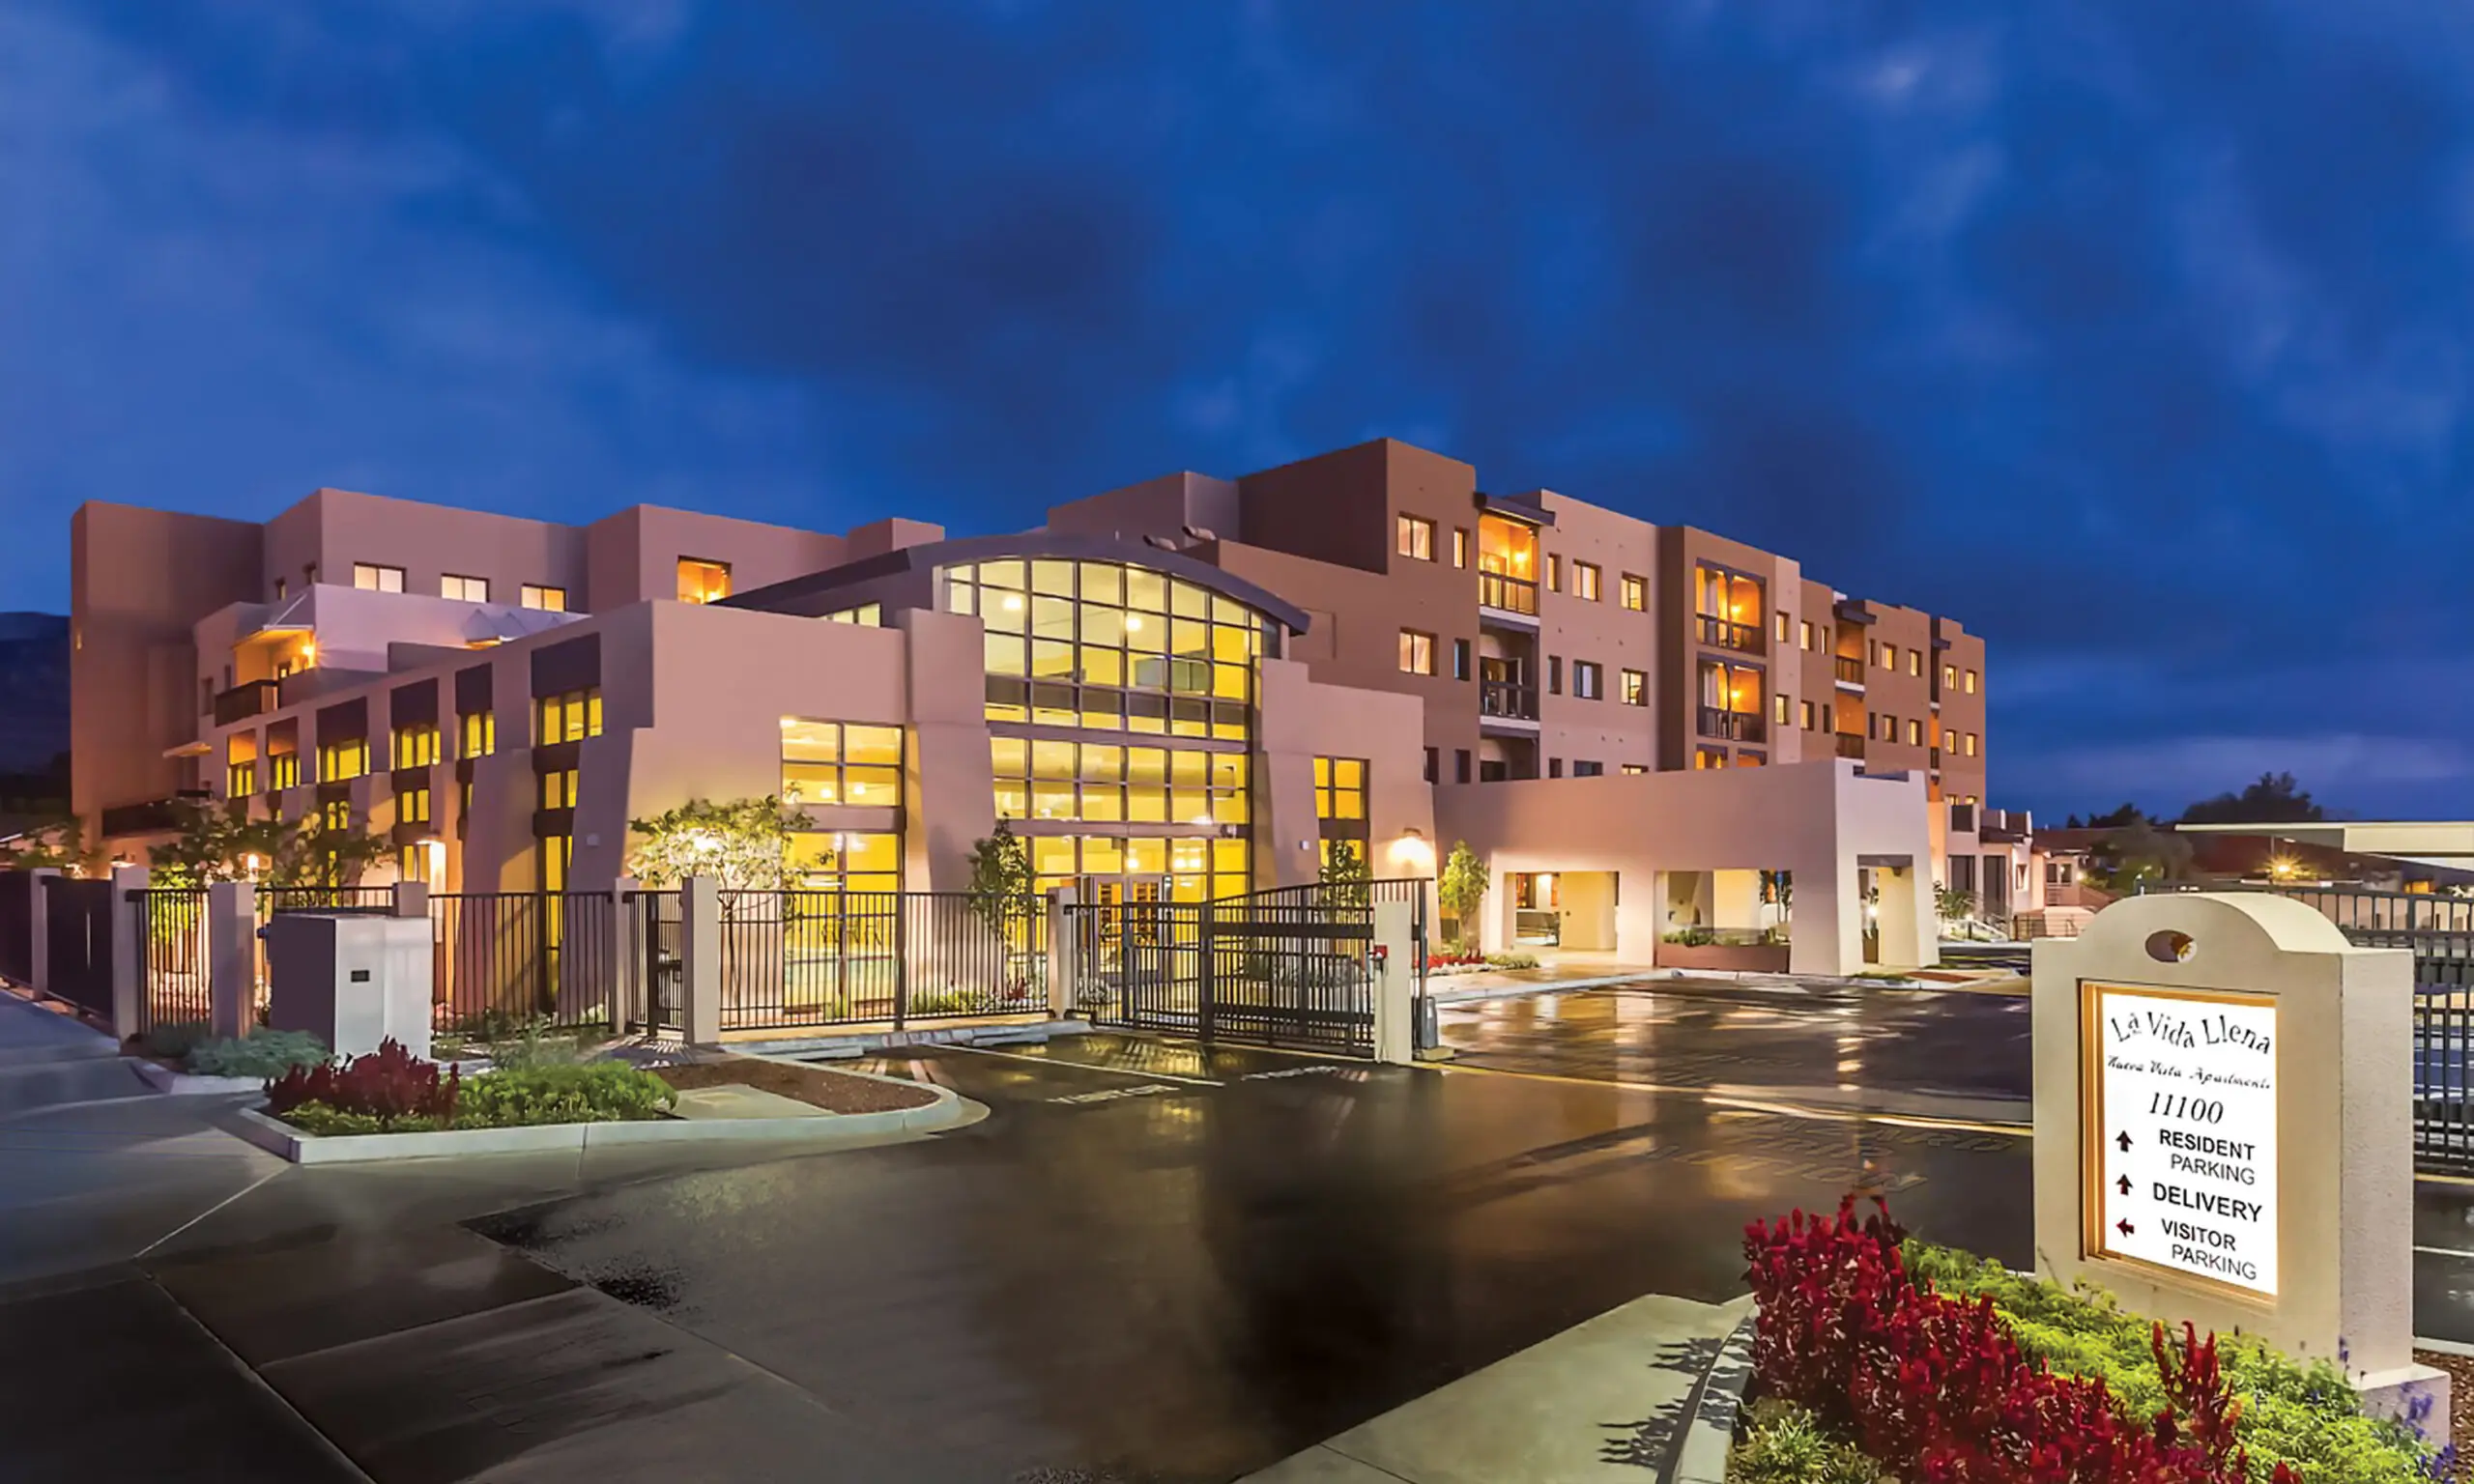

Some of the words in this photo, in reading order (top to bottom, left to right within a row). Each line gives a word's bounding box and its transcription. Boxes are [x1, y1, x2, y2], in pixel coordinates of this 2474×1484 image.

[2112, 1013, 2141, 1042] La
[2147, 1012, 2195, 1048] Vida
[2201, 1014, 2270, 1054] Llena
[2149, 1060, 2182, 1077] Vista
[2189, 1067, 2271, 1090] Apartments
[2149, 1093, 2223, 1124] 11100
[2160, 1128, 2255, 1160] RESIDENT
[2172, 1154, 2255, 1185] PARKING
[2153, 1183, 2262, 1222] DELIVERY
[2162, 1218, 2235, 1251] VISITOR
[2172, 1244, 2256, 1280] PARKING
